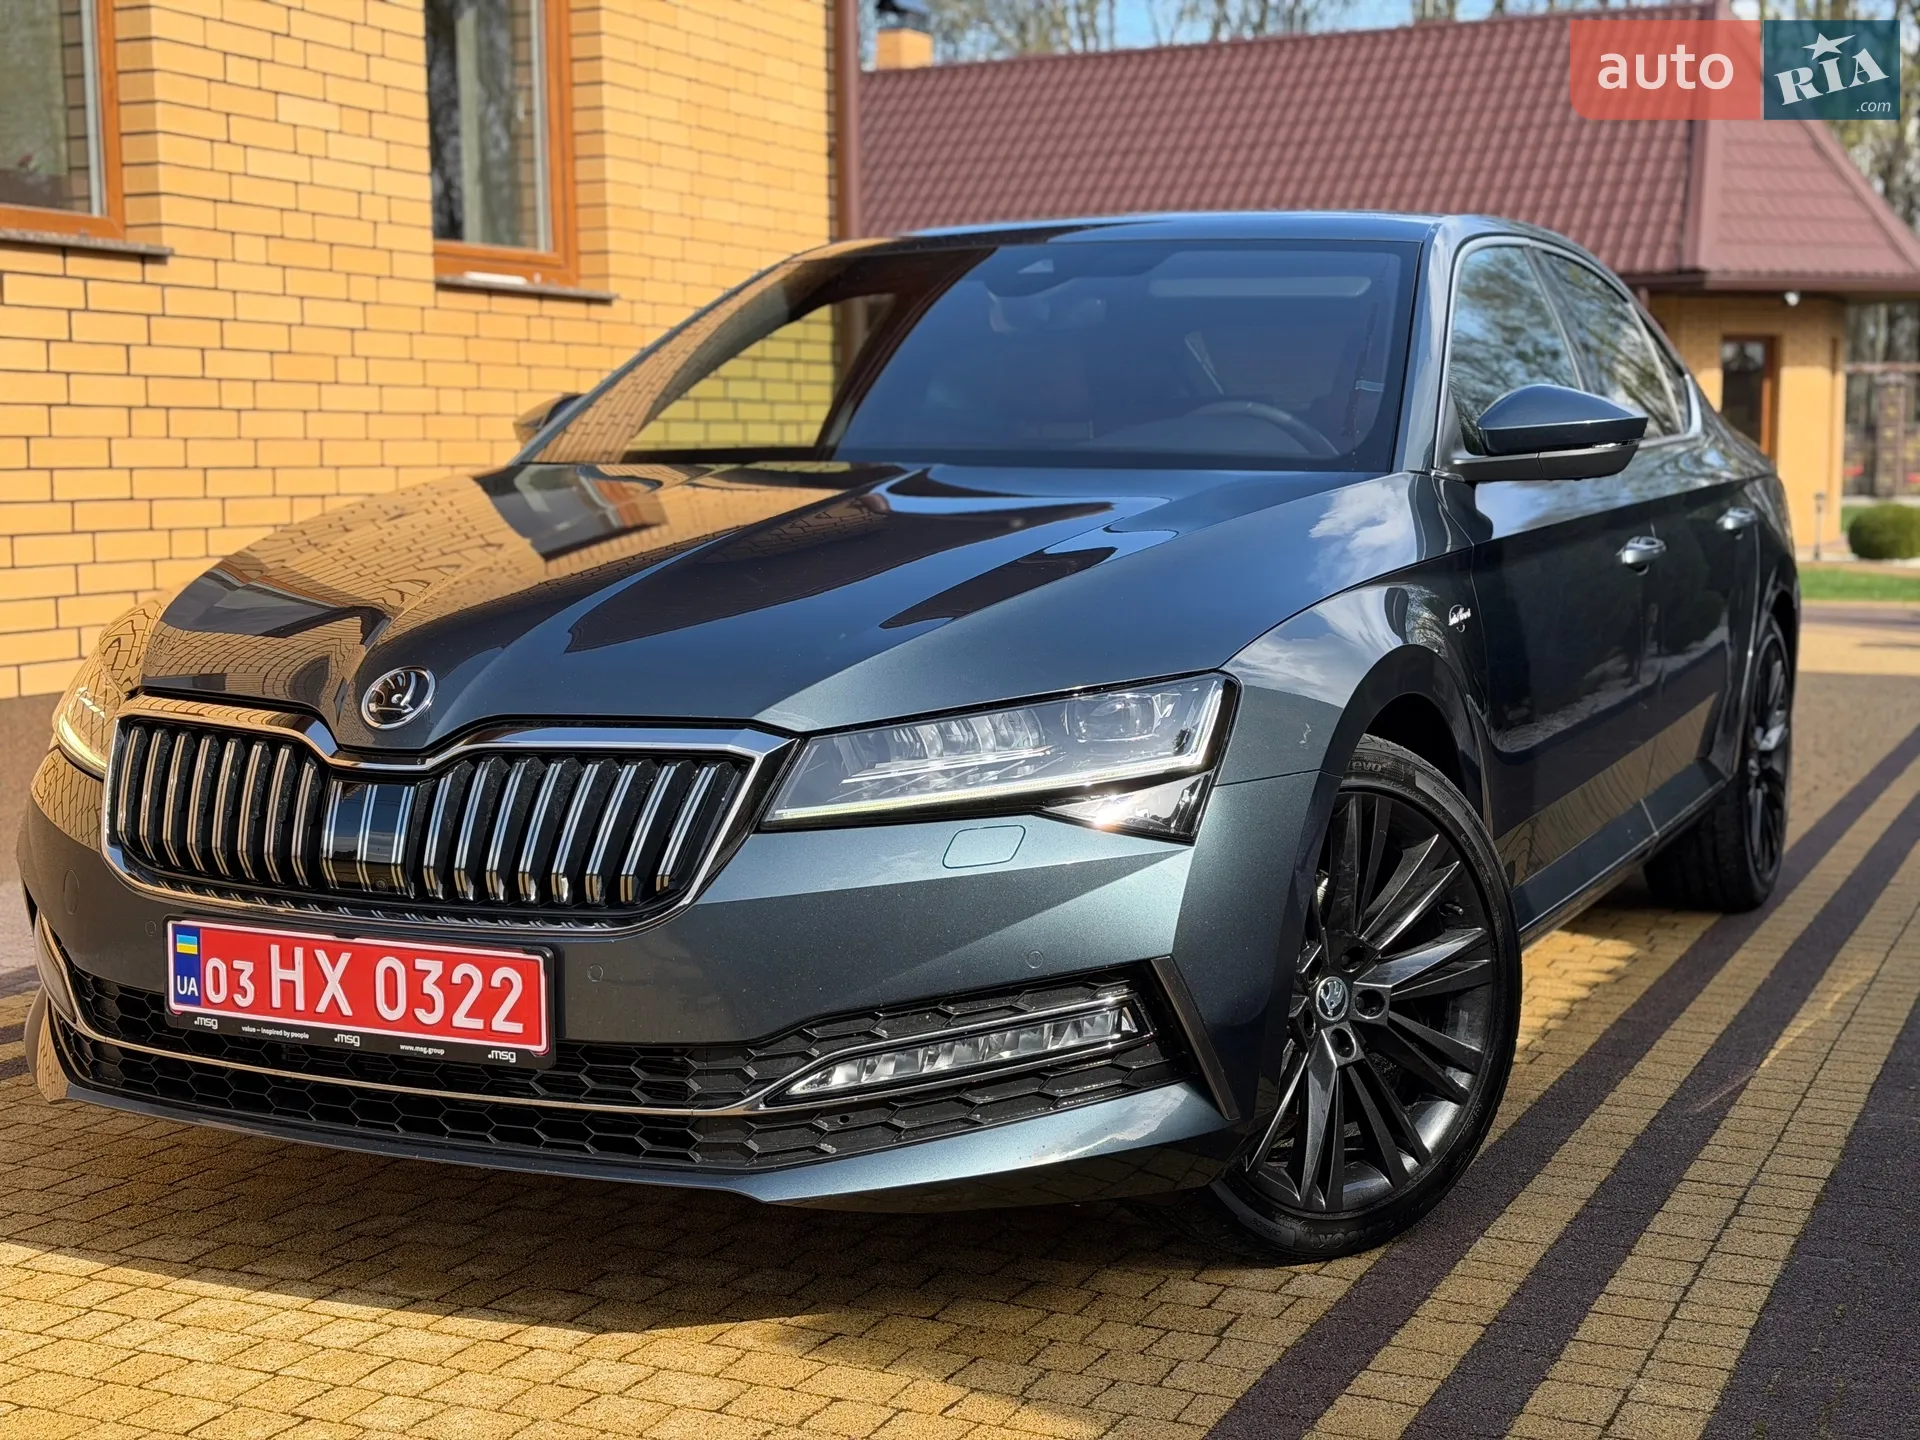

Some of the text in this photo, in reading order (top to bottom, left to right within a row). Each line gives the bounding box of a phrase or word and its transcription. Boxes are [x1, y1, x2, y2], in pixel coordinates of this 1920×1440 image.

[176, 975, 199, 997] UA
[204, 944, 525, 1034] 03 HX 0322
[194, 1016, 218, 1030] .msg
[241, 1025, 256, 1033] value
[261, 1027, 283, 1036] inspired
[283, 1029, 291, 1038] by
[290, 1031, 310, 1039] people
[334, 1033, 360, 1047] .msg
[399, 1044, 445, 1056] www.msg.group
[487, 1049, 517, 1063] .msg
